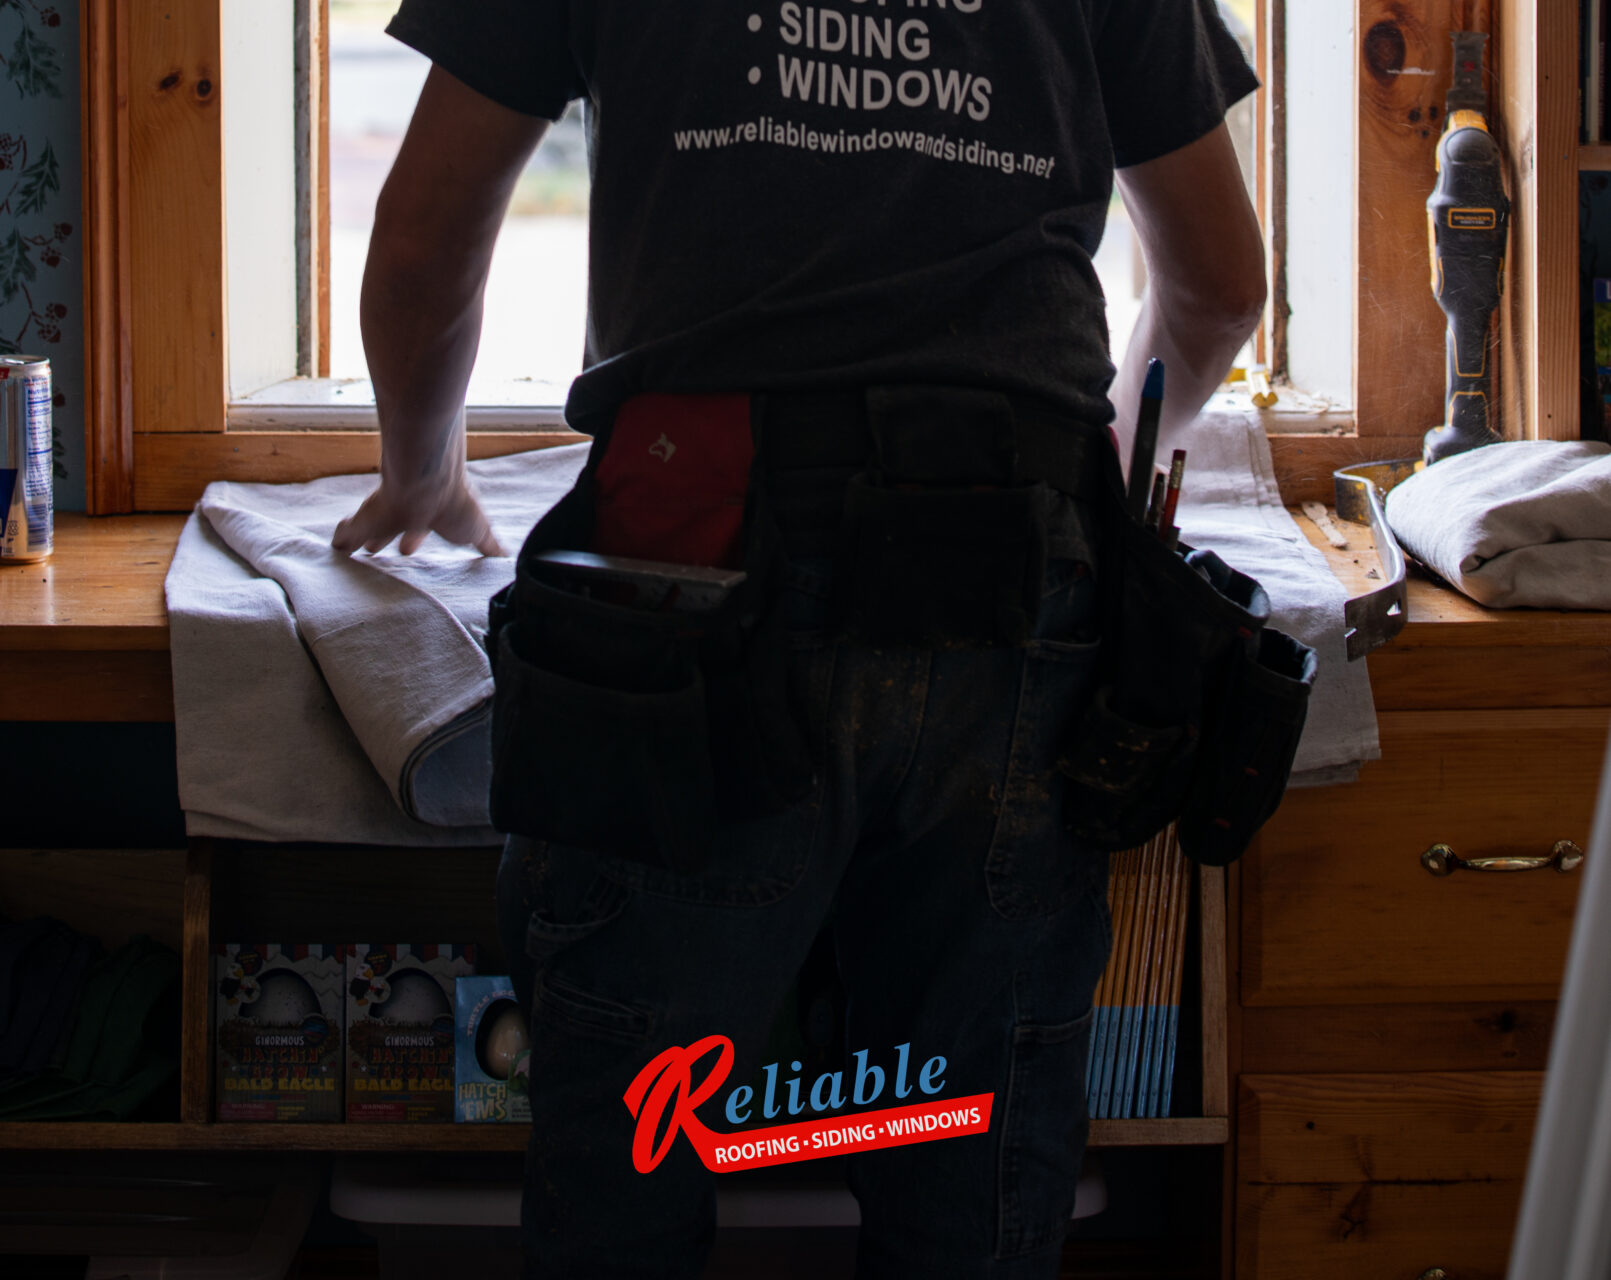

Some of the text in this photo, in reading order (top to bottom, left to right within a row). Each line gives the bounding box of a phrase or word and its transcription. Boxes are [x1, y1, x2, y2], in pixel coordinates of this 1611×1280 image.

[779, 1, 931, 61] SIDING
[778, 53, 992, 121] WINDOWS
[674, 116, 1055, 179] www.reliablewindowandsiding.net
[224, 1078, 336, 1091] BALD EAGLE
[353, 1078, 455, 1092] BALD EAGL
[458, 1082, 507, 1101] HATCH
